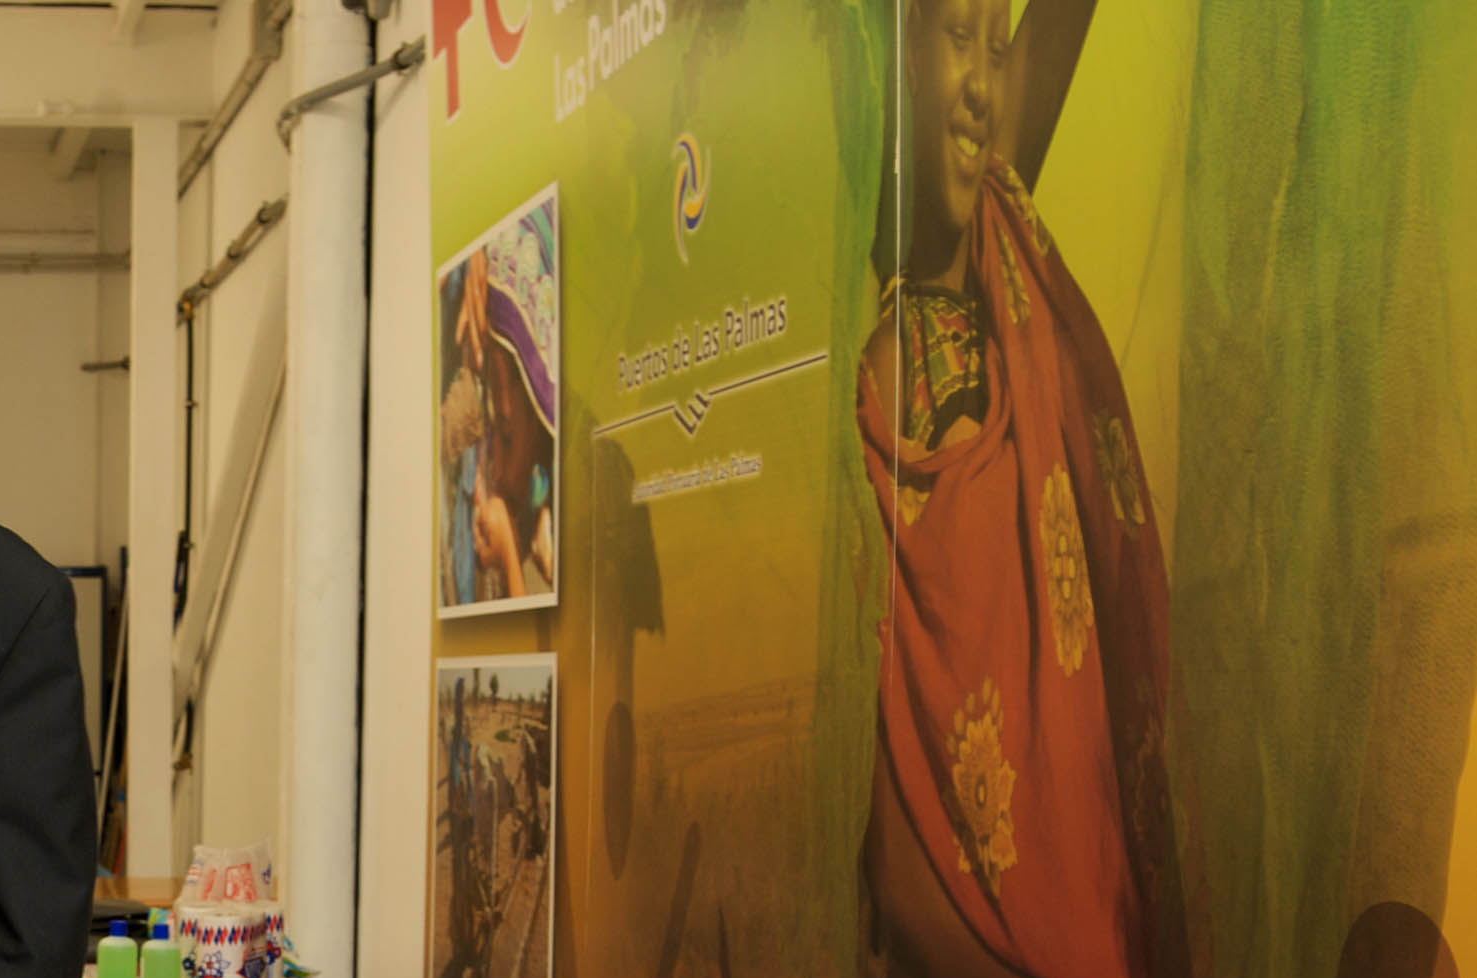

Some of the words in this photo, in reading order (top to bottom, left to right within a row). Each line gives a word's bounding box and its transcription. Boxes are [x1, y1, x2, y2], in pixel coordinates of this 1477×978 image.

[553, 52, 587, 123] Las
[587, 0, 667, 90] Palmas
[617, 346, 669, 393] Puertos
[671, 327, 690, 372] de
[694, 321, 720, 364] Las
[724, 297, 787, 353] Palmas
